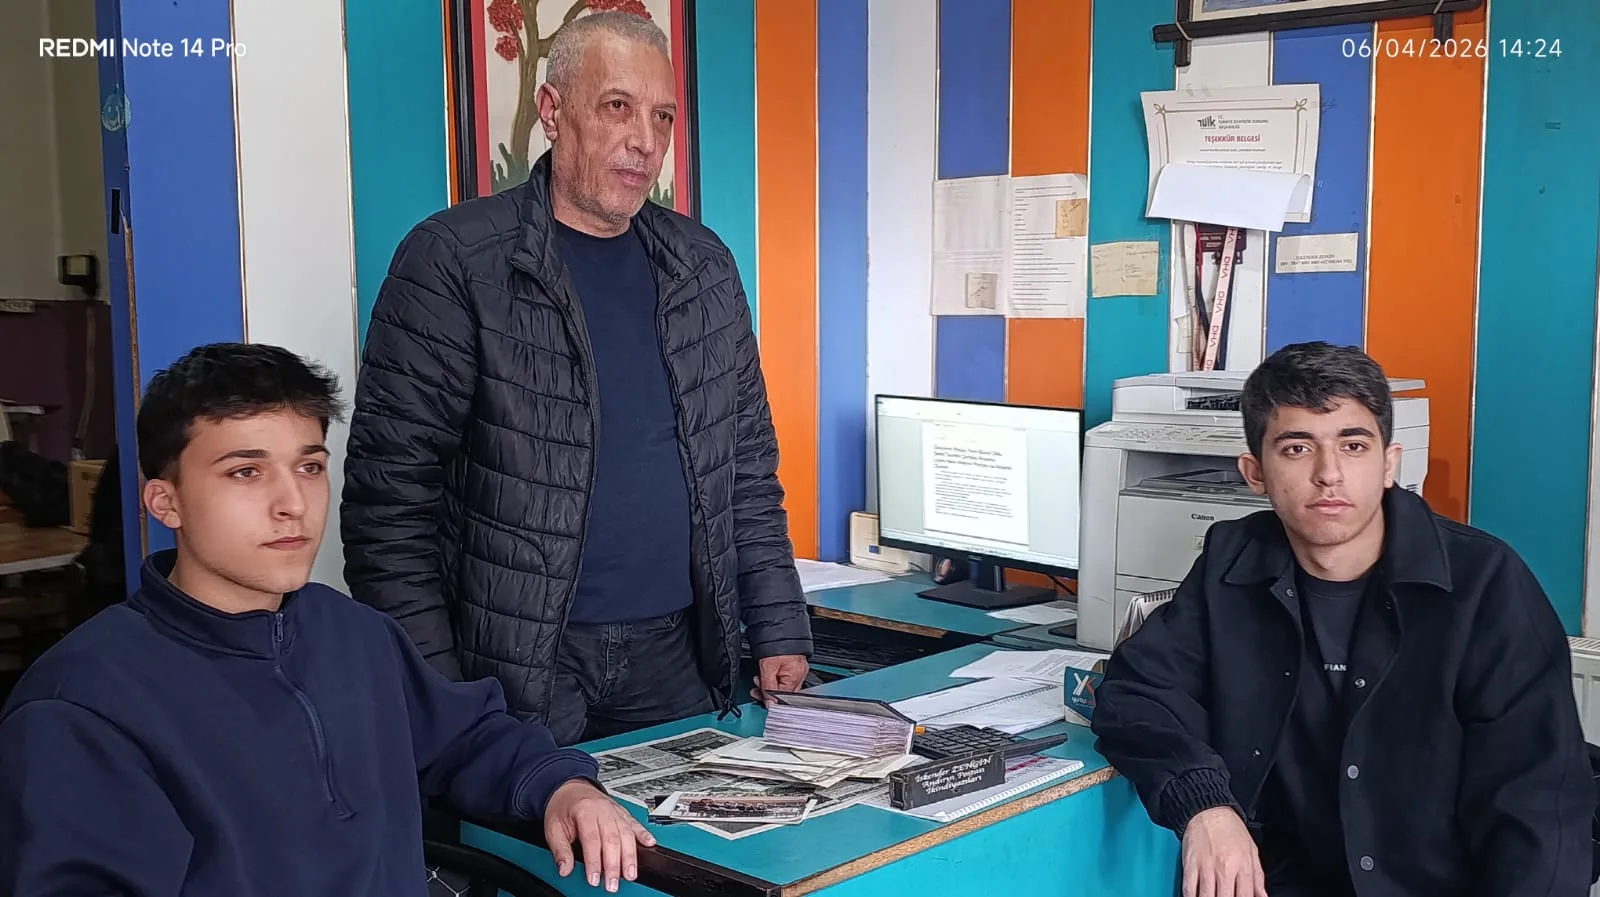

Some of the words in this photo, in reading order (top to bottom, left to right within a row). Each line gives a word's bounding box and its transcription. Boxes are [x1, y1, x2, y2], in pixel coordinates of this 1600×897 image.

[1204, 134, 1236, 143] TEŞEKKÜR
[1236, 133, 1261, 142] BELGESİ
[1190, 513, 1215, 521] Canon
